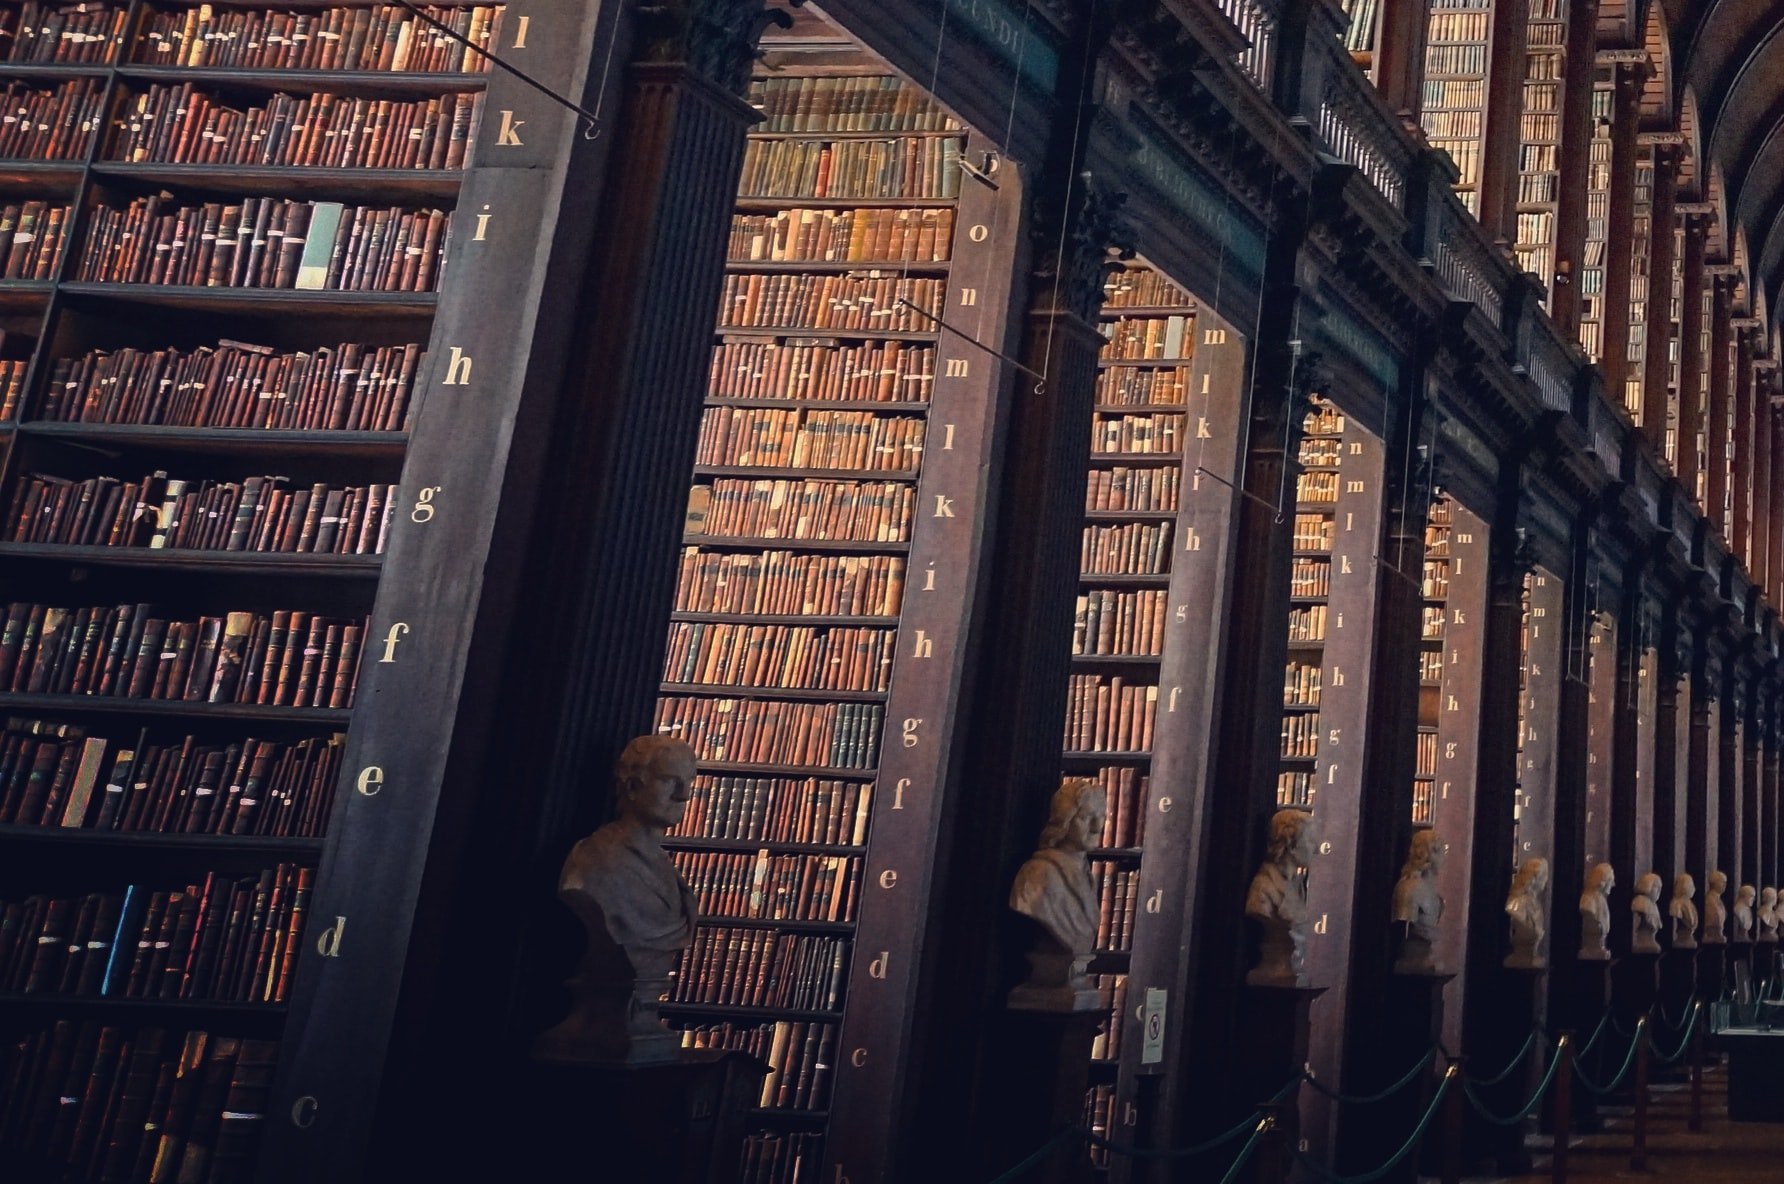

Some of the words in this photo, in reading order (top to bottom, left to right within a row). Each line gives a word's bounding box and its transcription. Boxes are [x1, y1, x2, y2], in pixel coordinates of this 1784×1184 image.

[513, 16, 529, 48] l
[496, 111, 524, 145] k
[472, 205, 491, 240] i
[970, 225, 987, 241] o
[961, 289, 976, 305] n
[1204, 330, 1225, 344] m
[443, 347, 471, 384] h
[946, 359, 968, 377] m
[1197, 417, 1210, 438] k
[412, 487, 441, 522] g
[934, 495, 954, 517] k
[1186, 528, 1199, 550] h
[1176, 603, 1188, 624] g
[380, 623, 409, 662] f
[914, 630, 932, 657] h
[903, 719, 923, 747] g
[358, 766, 383, 795] e
[1159, 797, 1171, 812] e
[880, 870, 897, 888] e
[1147, 890, 1162, 913] d
[318, 916, 346, 957] d
[870, 952, 889, 978] d
[852, 1048, 867, 1067] c
[292, 1096, 318, 1127] c
